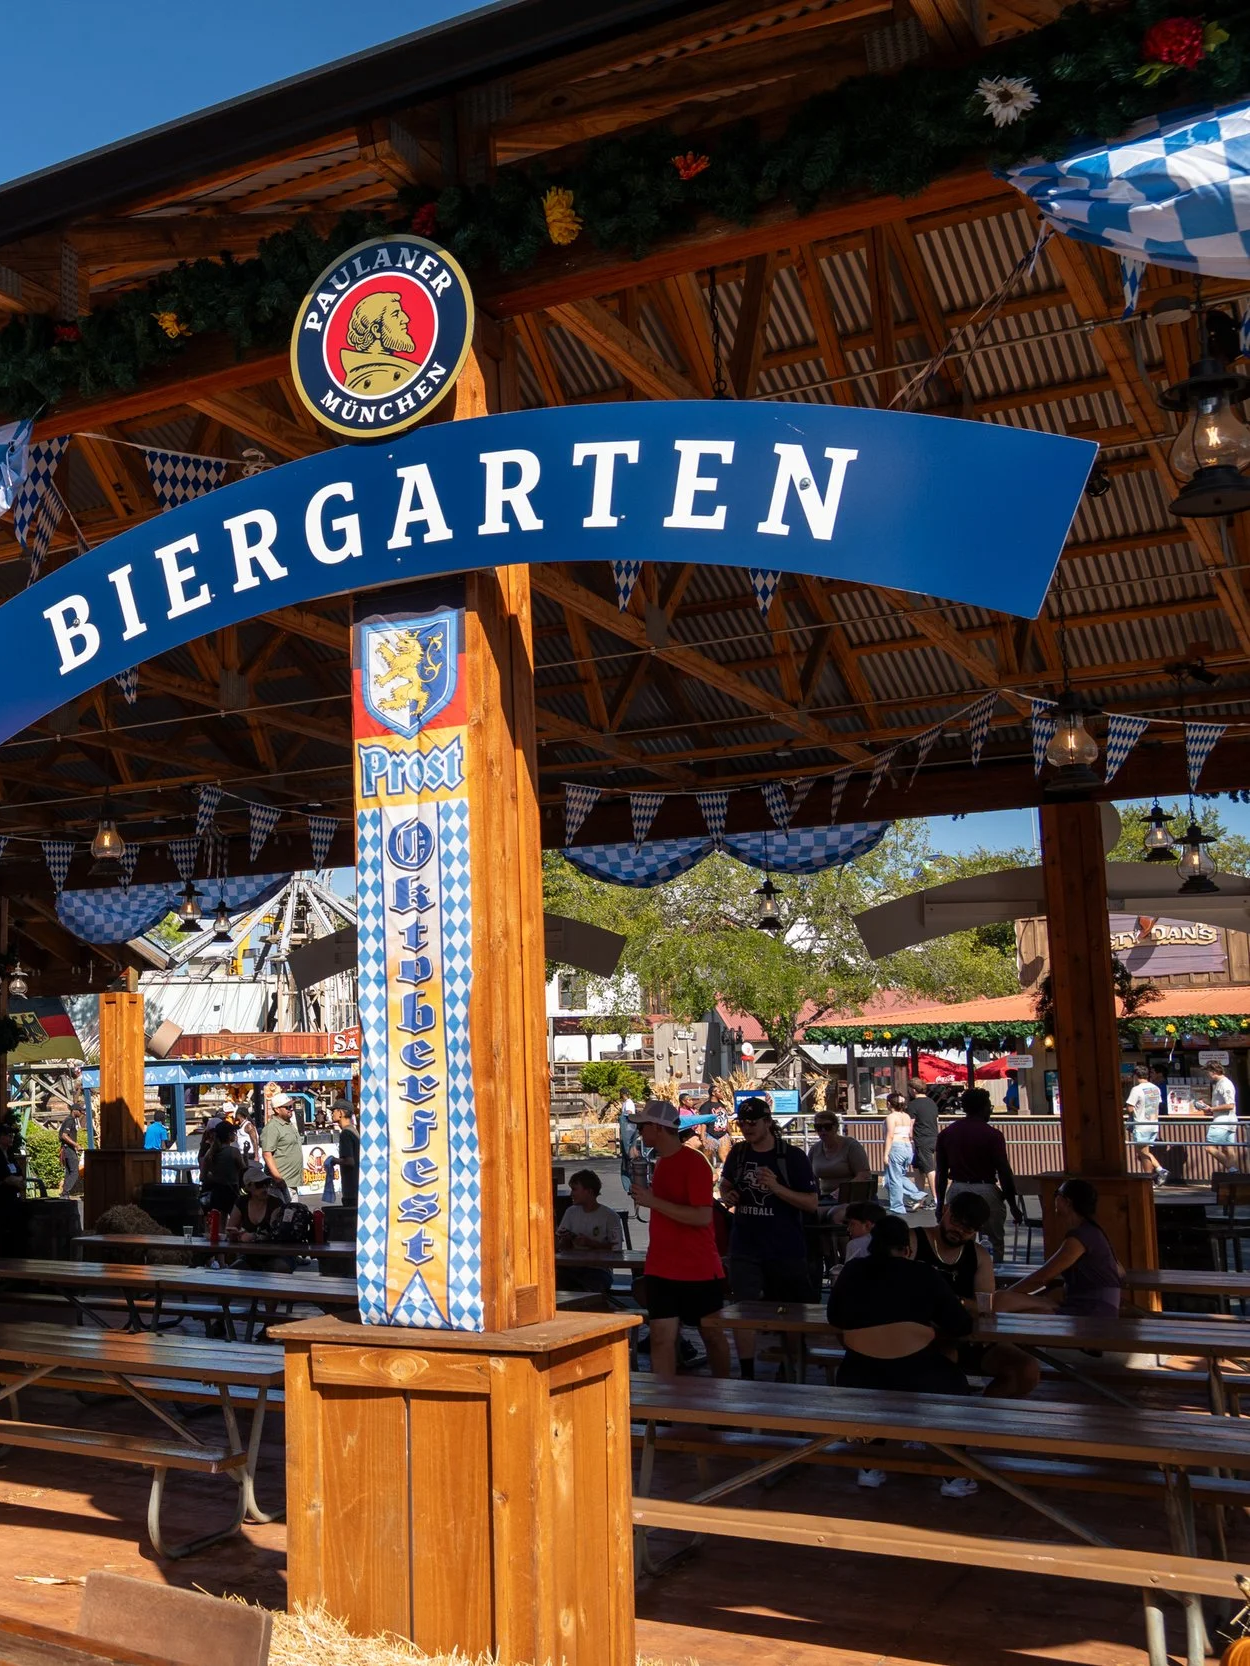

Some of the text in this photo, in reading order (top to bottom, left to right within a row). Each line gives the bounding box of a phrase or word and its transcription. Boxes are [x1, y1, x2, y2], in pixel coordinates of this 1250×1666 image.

[304, 247, 453, 332] PAULANER
[320, 361, 447, 422] MÜNCHEN
[42, 439, 859, 676] BIERGARTEN
[357, 734, 465, 798] Prost
[1151, 922, 1214, 941] DAN'S
[386, 817, 441, 1266] Oktoberfest
